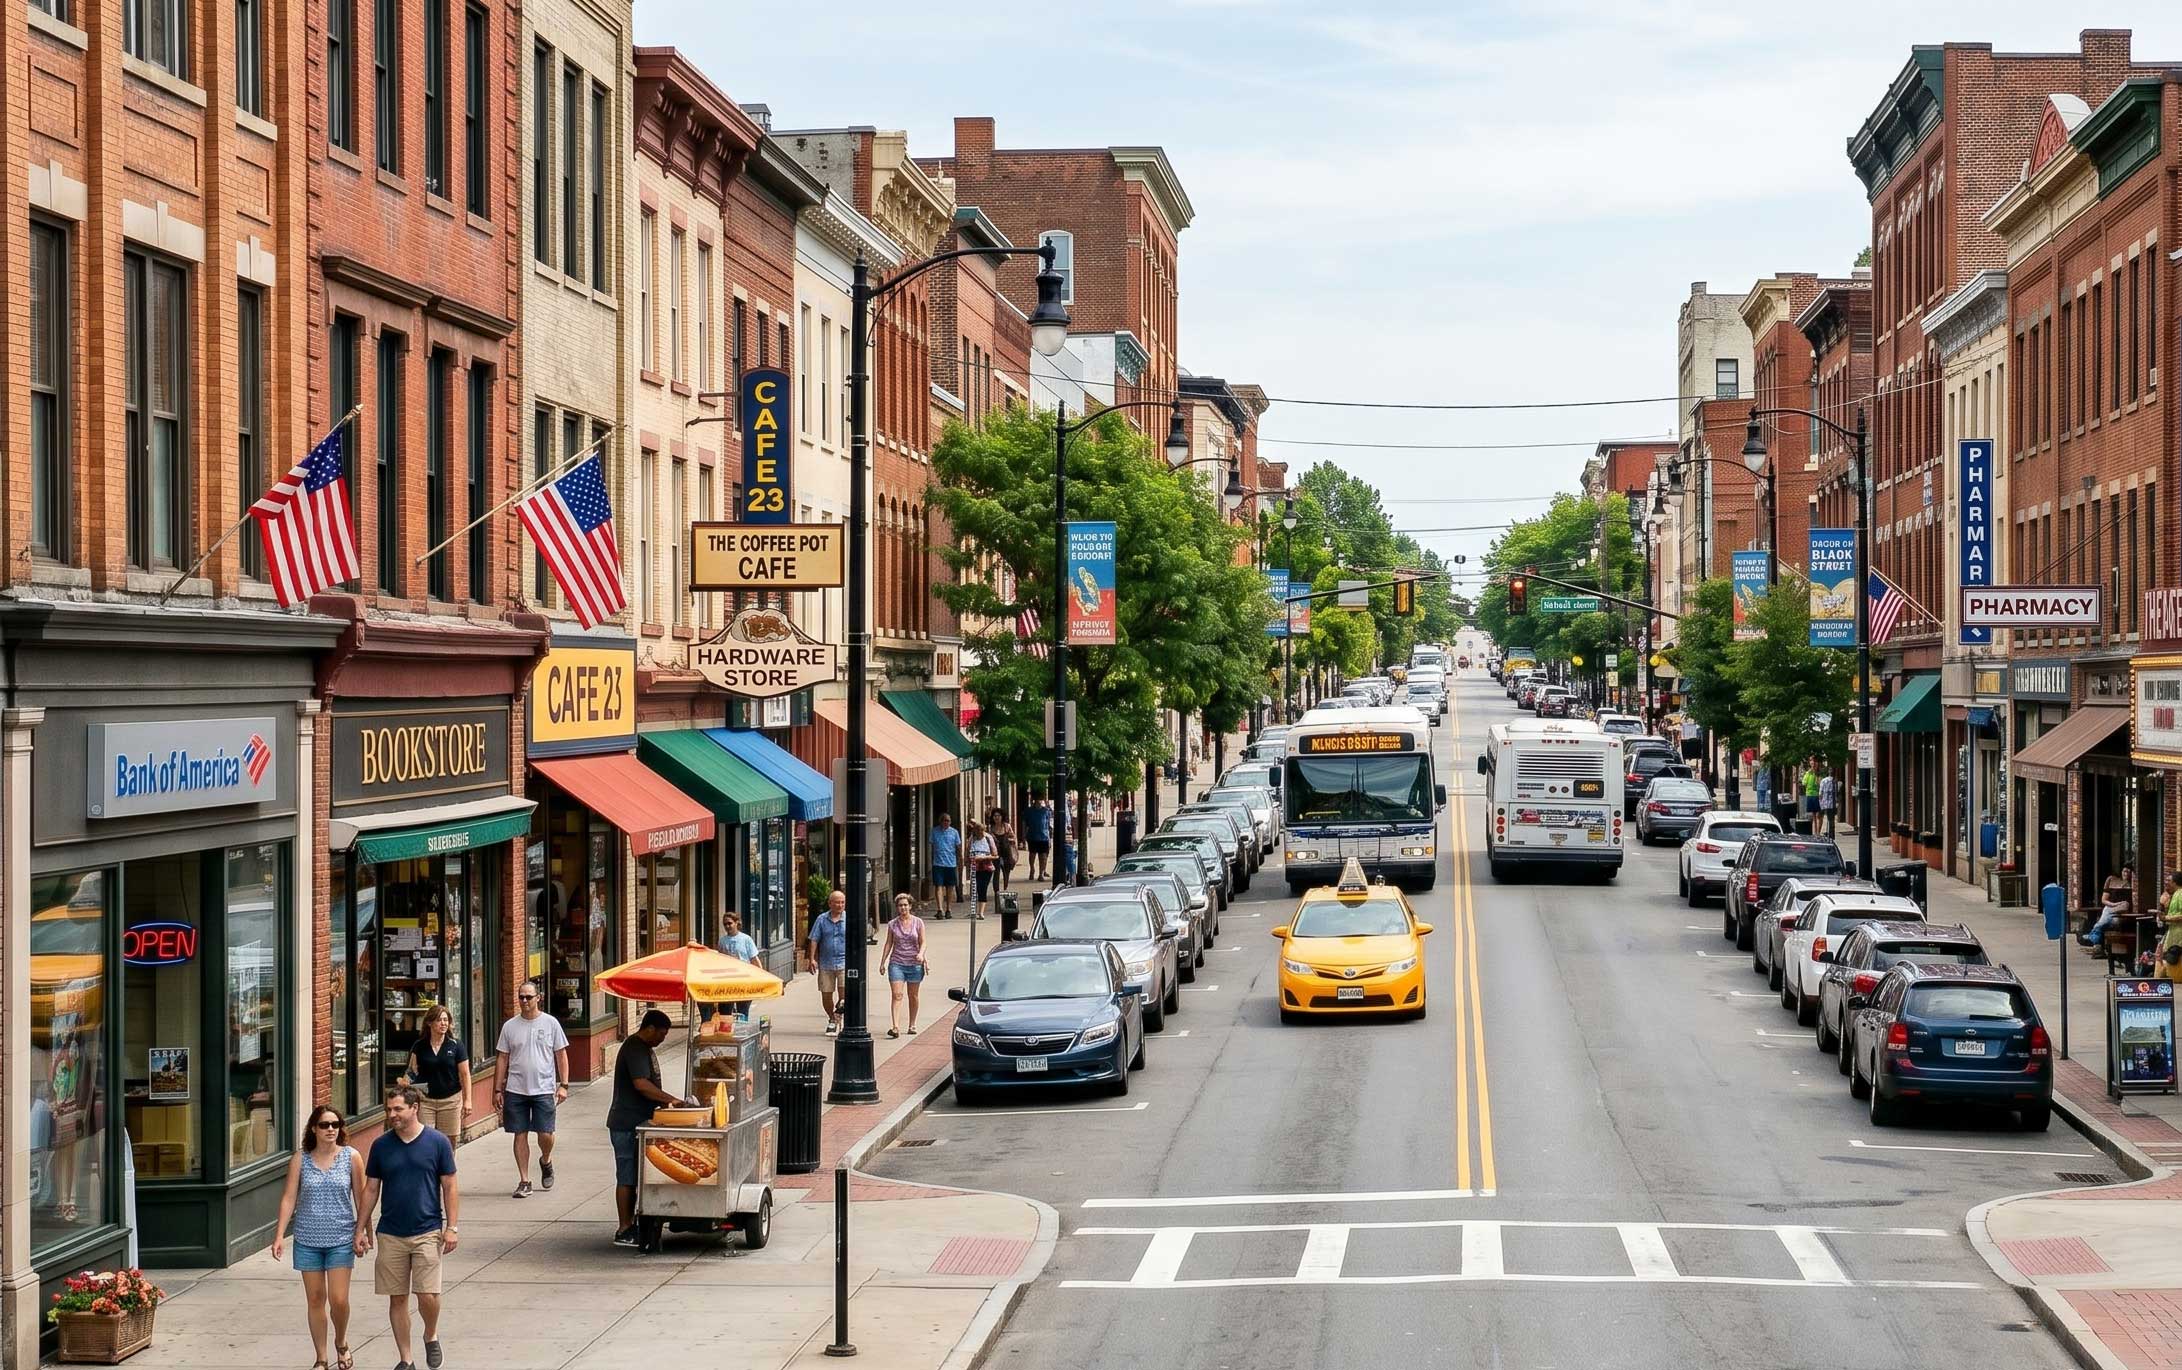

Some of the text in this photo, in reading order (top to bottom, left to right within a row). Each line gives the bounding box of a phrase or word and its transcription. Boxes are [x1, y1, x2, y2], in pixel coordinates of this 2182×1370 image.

[753, 381, 778, 484] CAFE
[747, 487, 785, 512] 23
[1967, 447, 1985, 586] PHARMAR
[708, 535, 829, 552] THE COFFEE POT
[738, 557, 797, 580] CAFE
[1970, 598, 2093, 615] PHARMACY
[697, 648, 825, 665] HARDWARE
[724, 669, 798, 686] STORE
[548, 665, 622, 724] CAFE 23
[361, 722, 486, 785] BOOKSTORE
[116, 748, 240, 797] Bank of America
[123, 928, 196, 957] OPEN
